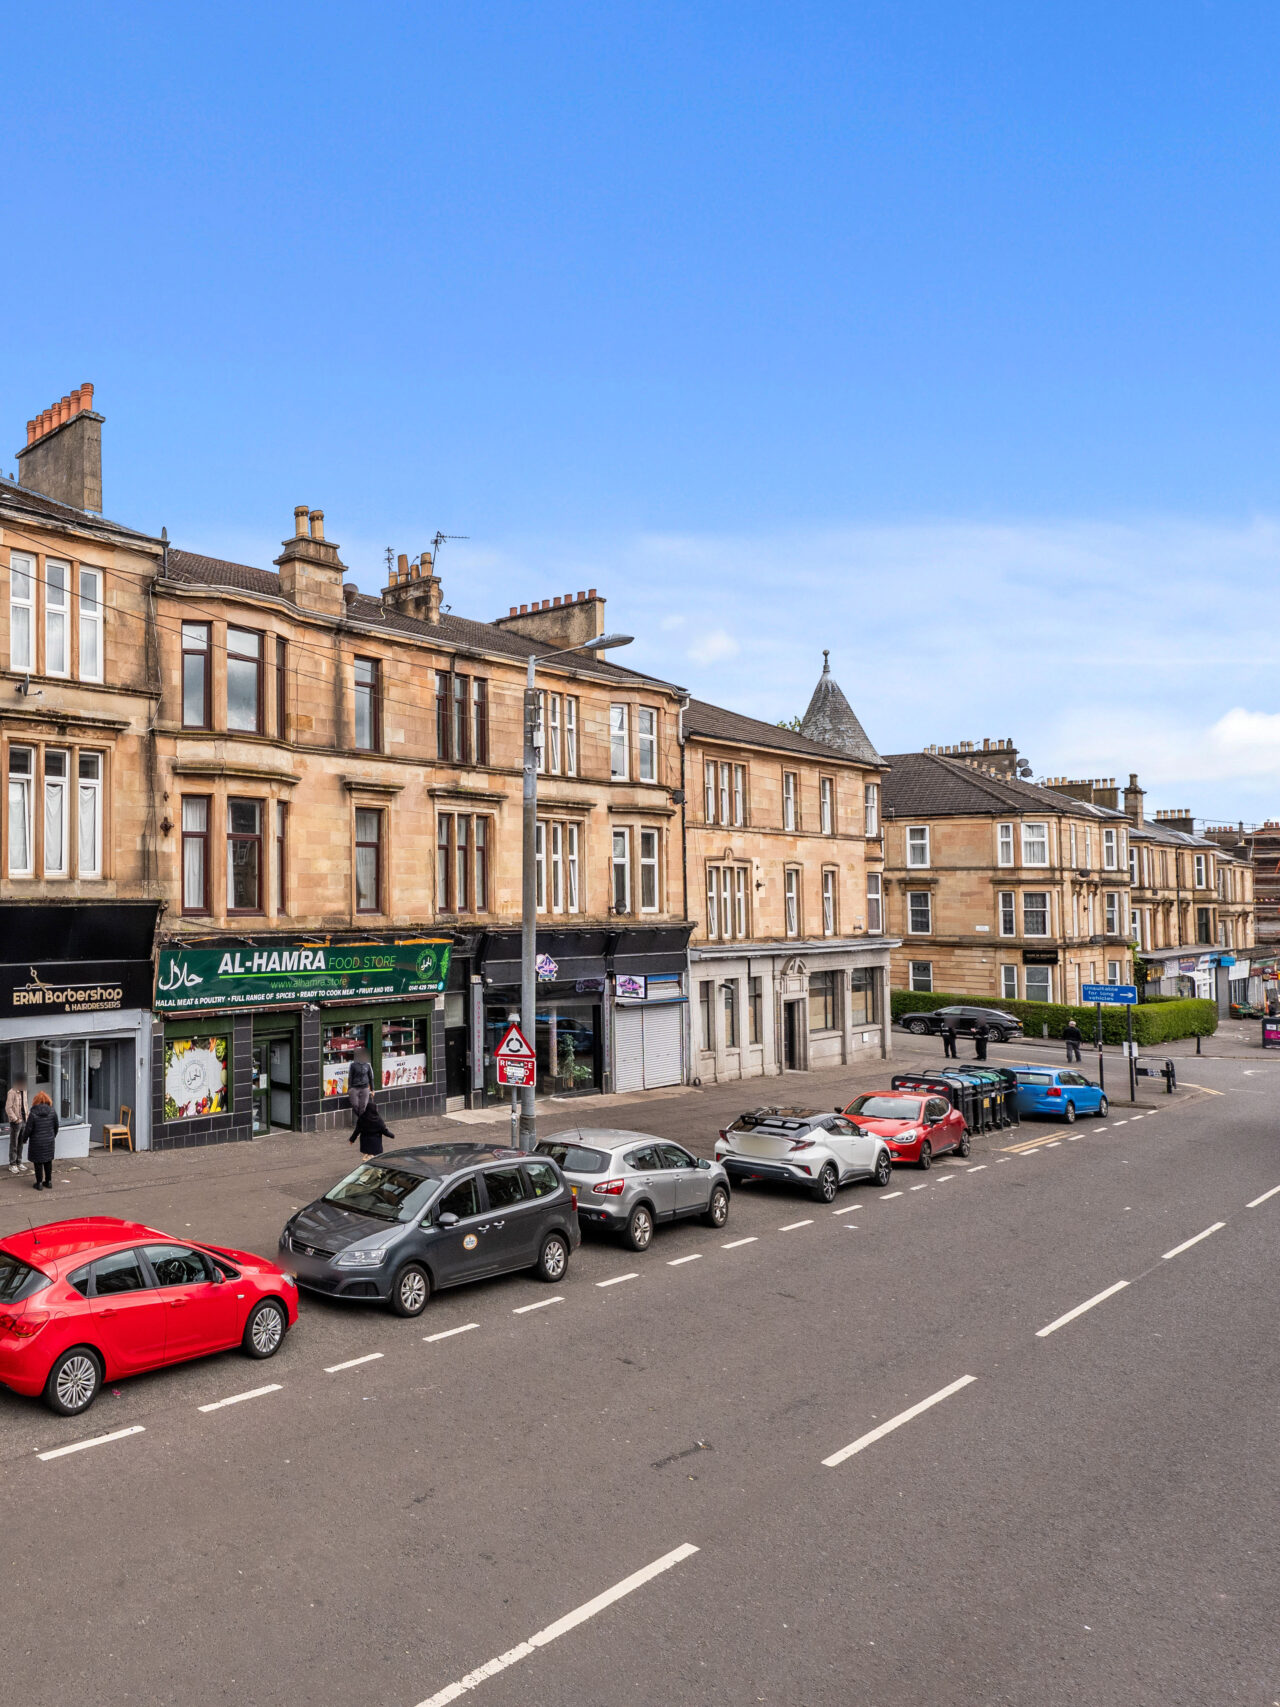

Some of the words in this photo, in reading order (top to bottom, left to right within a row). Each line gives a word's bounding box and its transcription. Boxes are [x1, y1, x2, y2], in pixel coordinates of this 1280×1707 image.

[217, 950, 326, 974] AL-HAMRA
[328, 957, 360, 969] FOOD
[363, 955, 398, 968] STORE
[270, 976, 348, 989] www.alhamra.store
[12, 991, 43, 1005] ERMI
[45, 987, 122, 1003] Barbershop
[231, 994, 245, 1002] FULL
[265, 992, 274, 1000] OF
[275, 991, 296, 999] SPICES
[299, 989, 317, 997] READY
[318, 989, 326, 997] TO
[342, 988, 355, 996] MEAT
[65, 1003, 71, 1012] &
[72, 1001, 121, 1011] HAIRDRESSERS
[155, 999, 176, 1007] HALAL
[177, 998, 194, 1006] MEAT
[200, 996, 226, 1004] POULTRY
